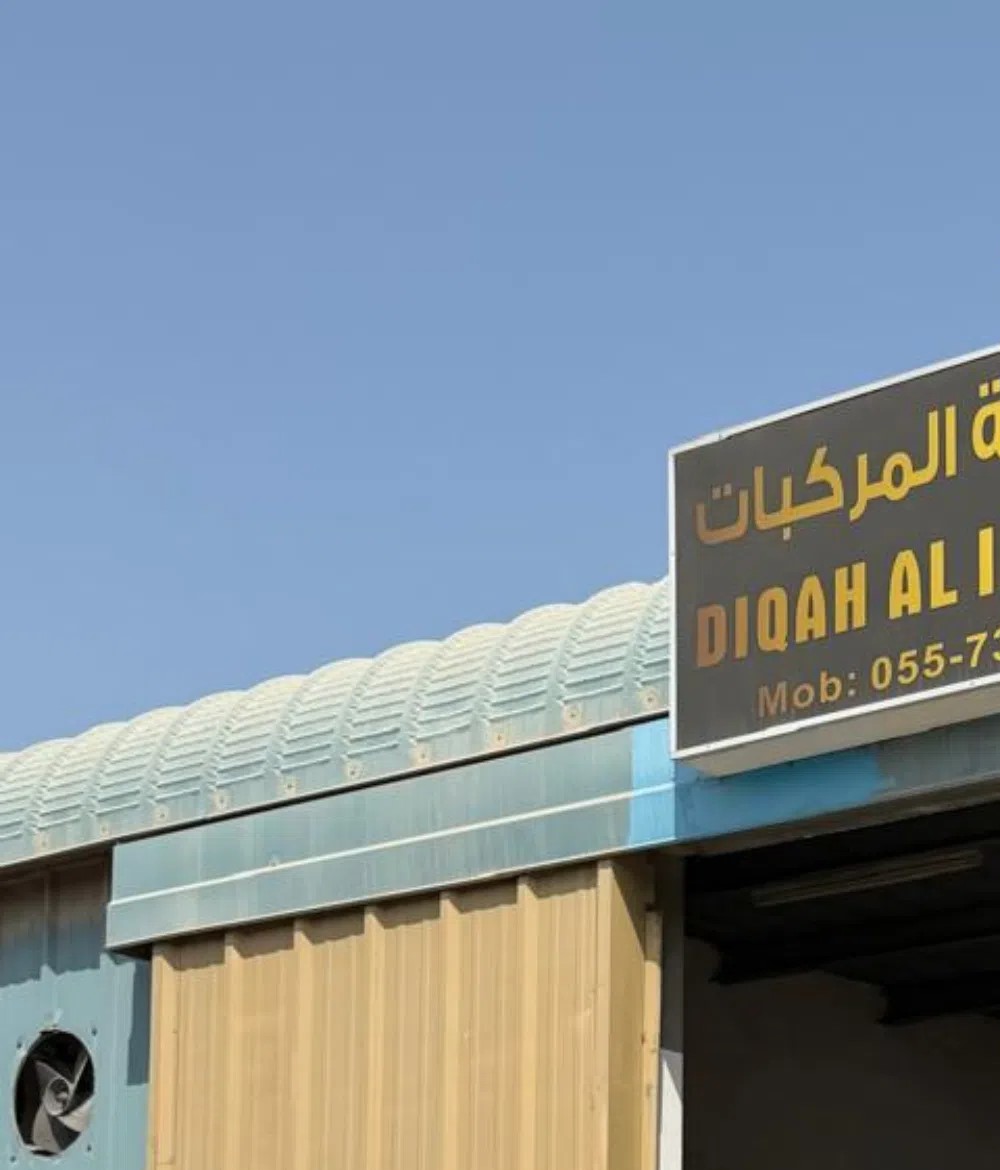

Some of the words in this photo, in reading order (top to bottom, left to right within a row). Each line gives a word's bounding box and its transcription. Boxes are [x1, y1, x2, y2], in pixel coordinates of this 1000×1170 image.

[696, 405, 957, 544] المركبات
[697, 562, 867, 667] DIQAH
[887, 540, 959, 619] AL
[758, 670, 856, 718] Mob:
